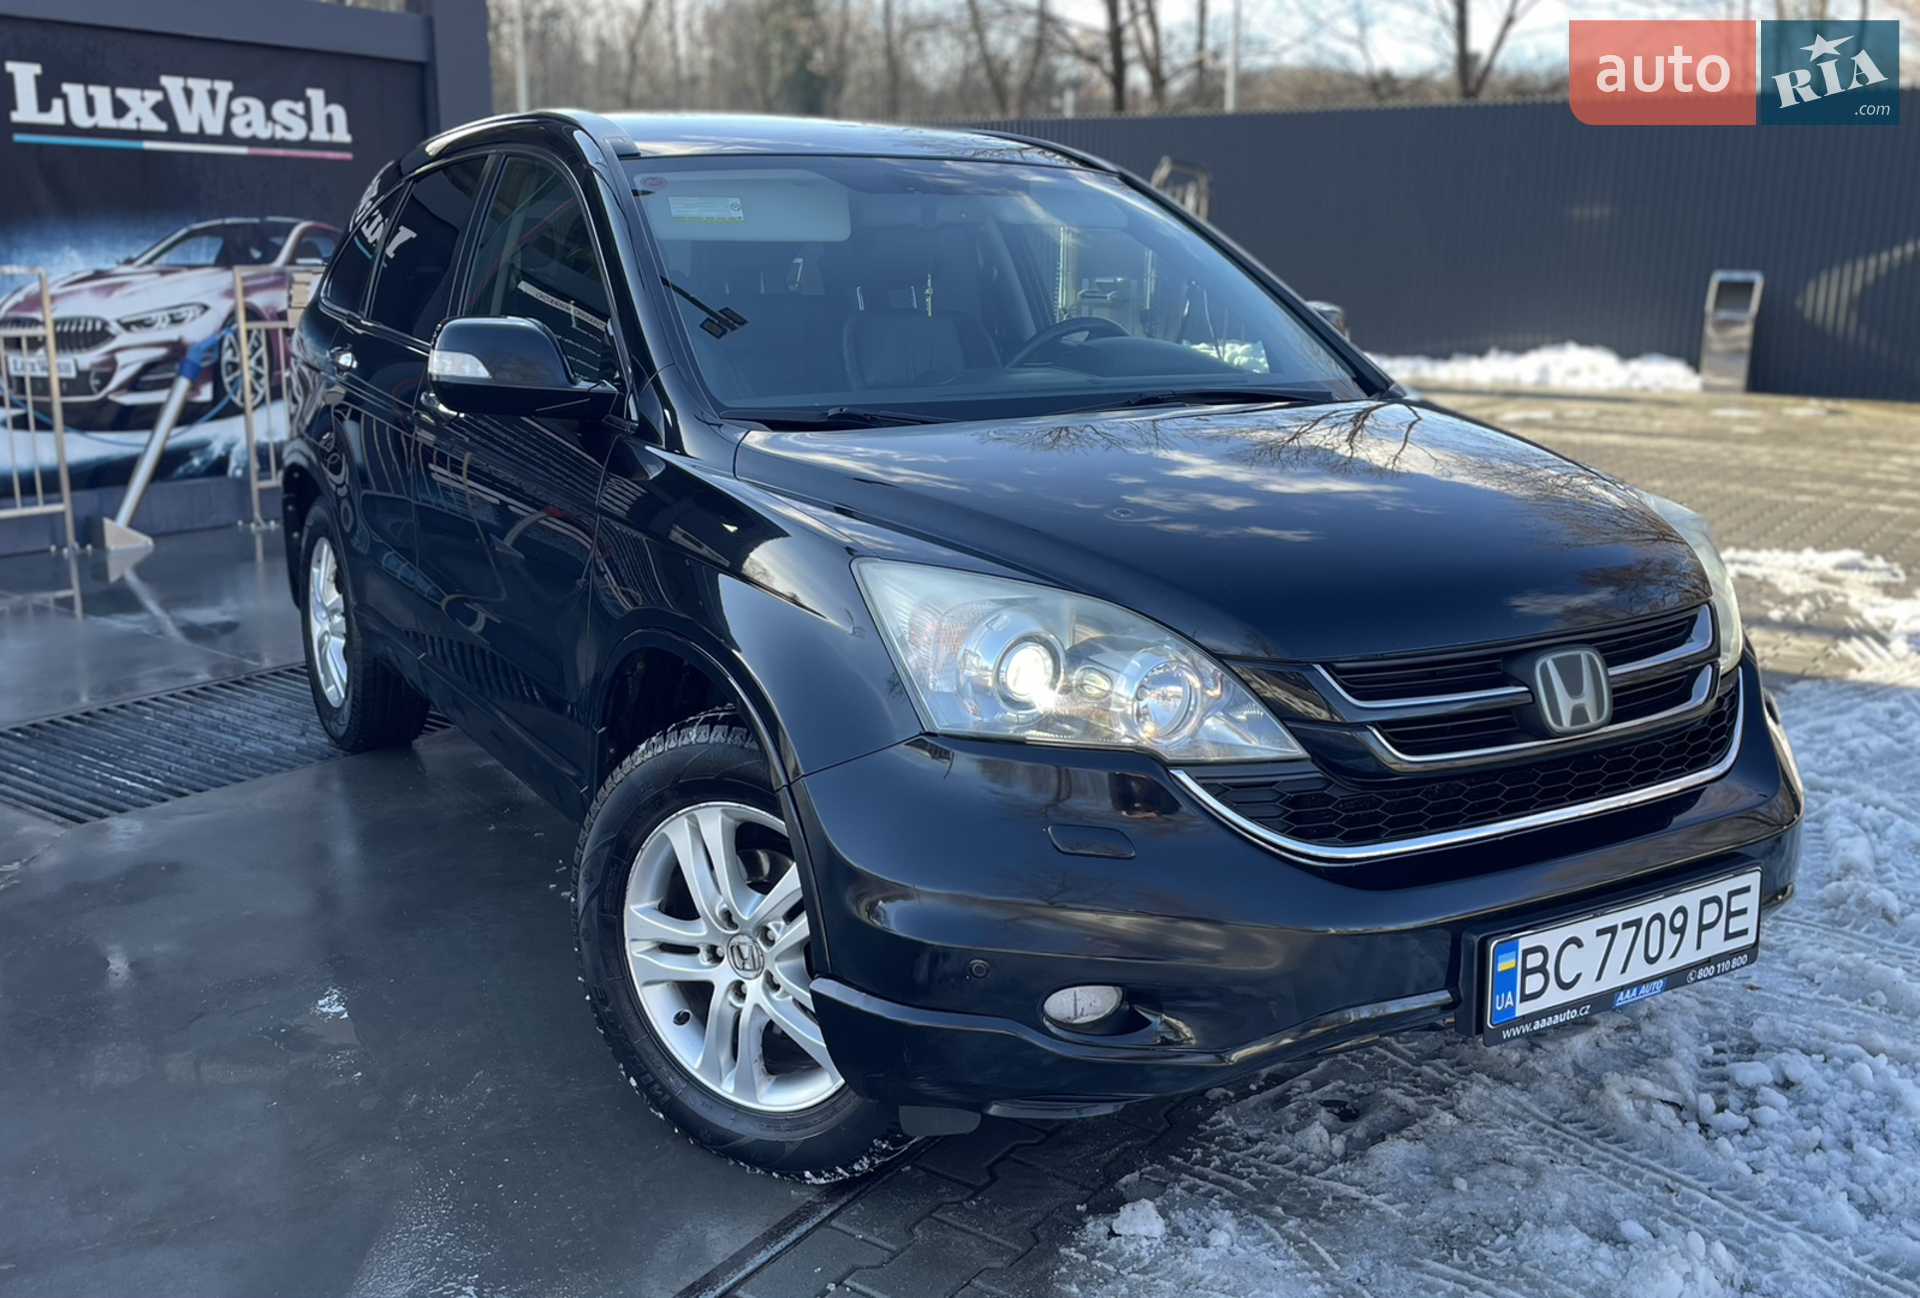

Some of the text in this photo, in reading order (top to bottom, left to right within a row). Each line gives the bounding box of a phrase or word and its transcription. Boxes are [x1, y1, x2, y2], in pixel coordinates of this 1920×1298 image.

[4, 60, 353, 144] LuxWash
[1519, 884, 1752, 1005] BC 7709 PE
[1697, 966, 1715, 981] 800
[1495, 991, 1515, 1011] UA
[1615, 979, 1664, 1003] AAA AUTO
[1501, 1003, 1592, 1040] www.aaaauto.cz
